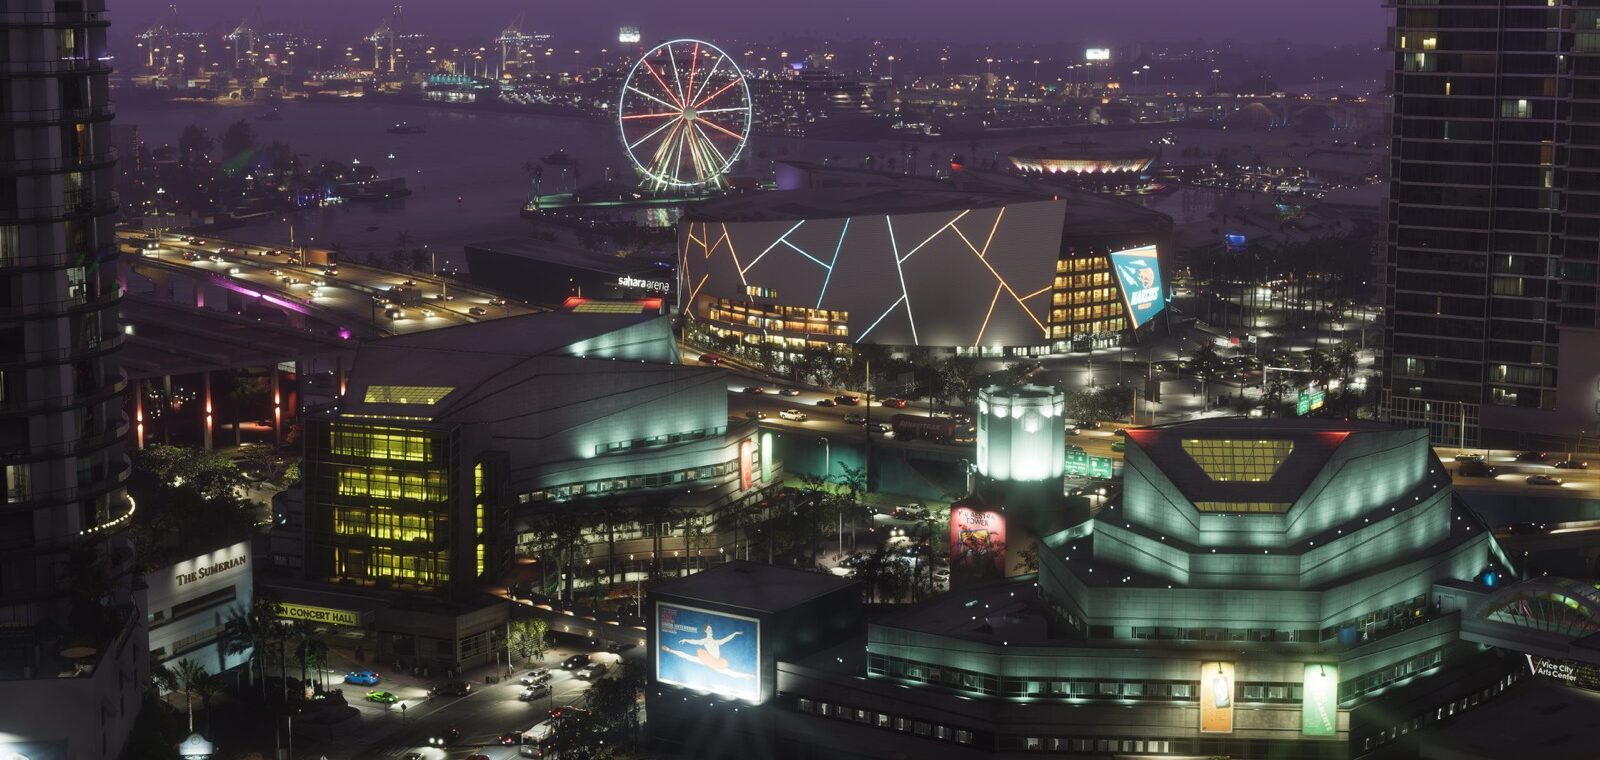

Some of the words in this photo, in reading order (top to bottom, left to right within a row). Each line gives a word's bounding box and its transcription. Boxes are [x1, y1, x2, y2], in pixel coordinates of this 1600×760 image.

[618, 275, 646, 288] sahara
[646, 280, 670, 292] arena
[966, 517, 989, 526] TOWER
[290, 608, 330, 620] CONCERT
[332, 613, 353, 624] HALL
[1537, 667, 1551, 677] Arts
[1552, 671, 1577, 682] Center
[1542, 660, 1558, 670] Vice
[1559, 665, 1574, 675] City
